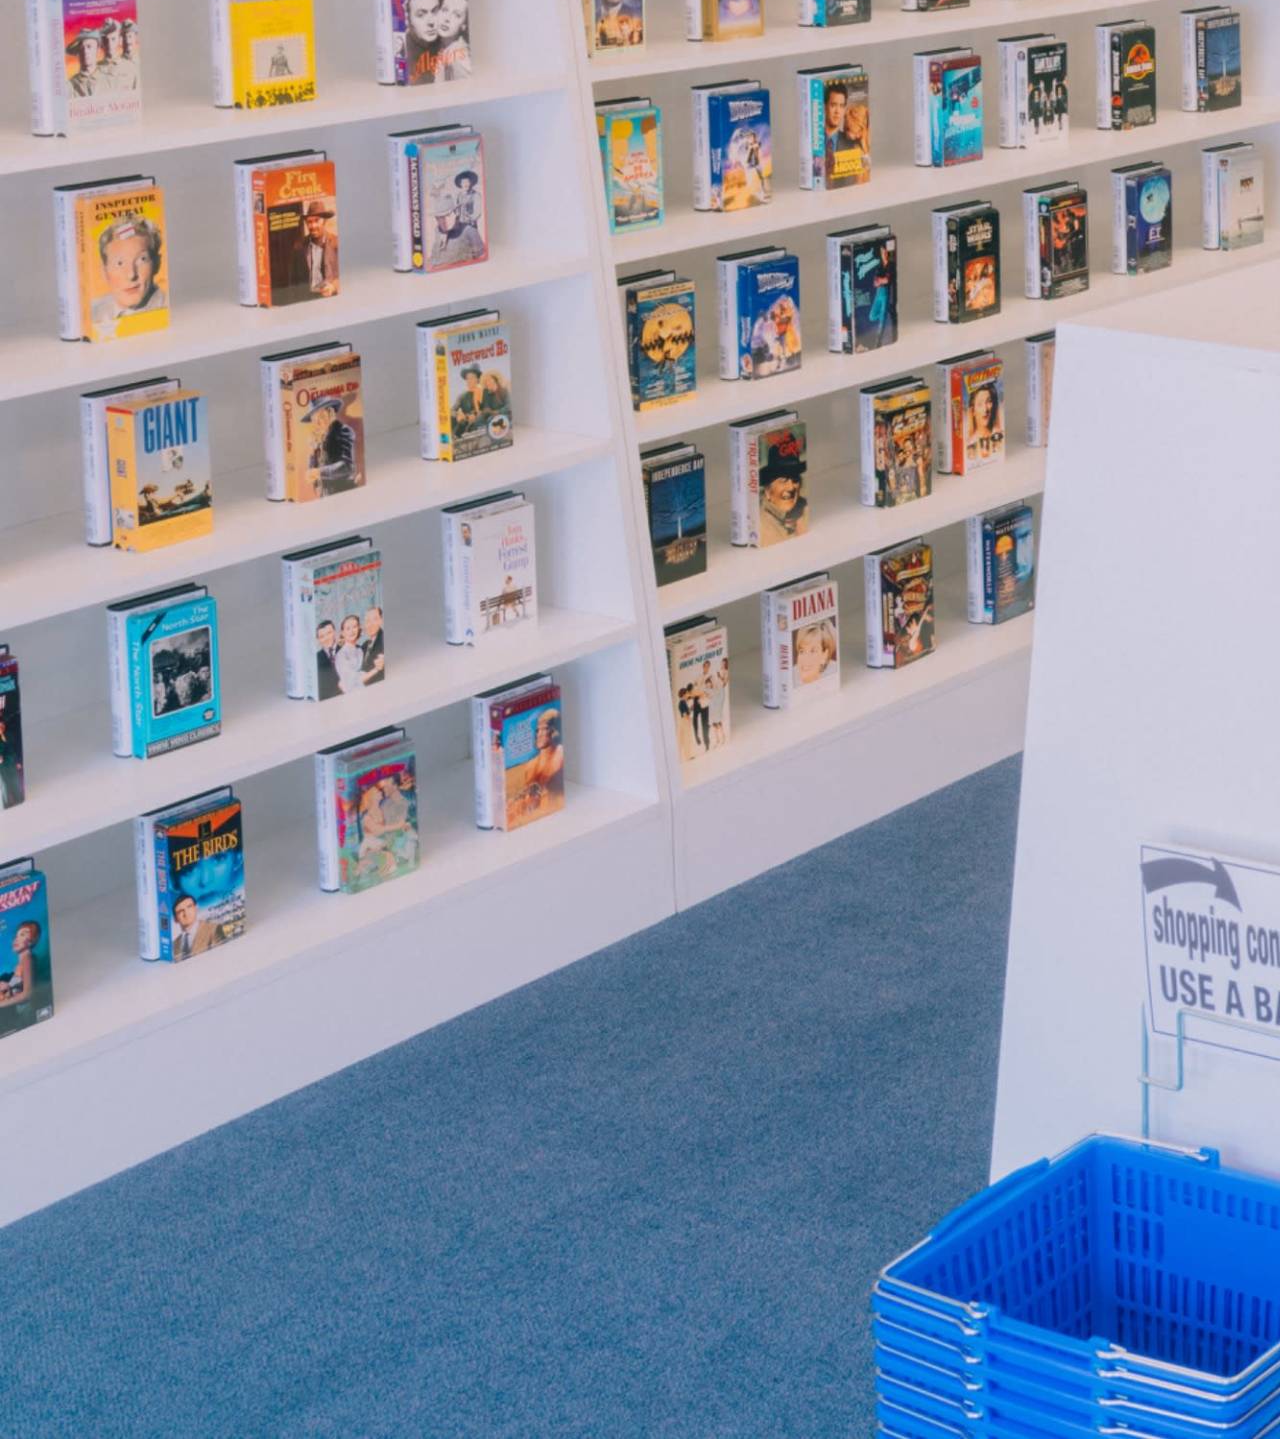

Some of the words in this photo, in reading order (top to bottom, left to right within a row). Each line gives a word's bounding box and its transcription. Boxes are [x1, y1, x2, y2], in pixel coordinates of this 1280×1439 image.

[96, 194, 156, 210] INSPECTOR
[966, 221, 992, 234] STAR
[966, 231, 992, 243] WARS
[143, 397, 200, 454] GIANT
[749, 442, 758, 468] TRUE
[653, 462, 692, 482] INDEPENDENCE
[749, 470, 758, 494] GRIT
[792, 587, 835, 620] DIANA
[173, 844, 200, 871] THE
[203, 830, 238, 859] BIRDS
[1153, 895, 1241, 971] shopping
[1160, 964, 1216, 1011] USE
[1225, 980, 1245, 1017] A
